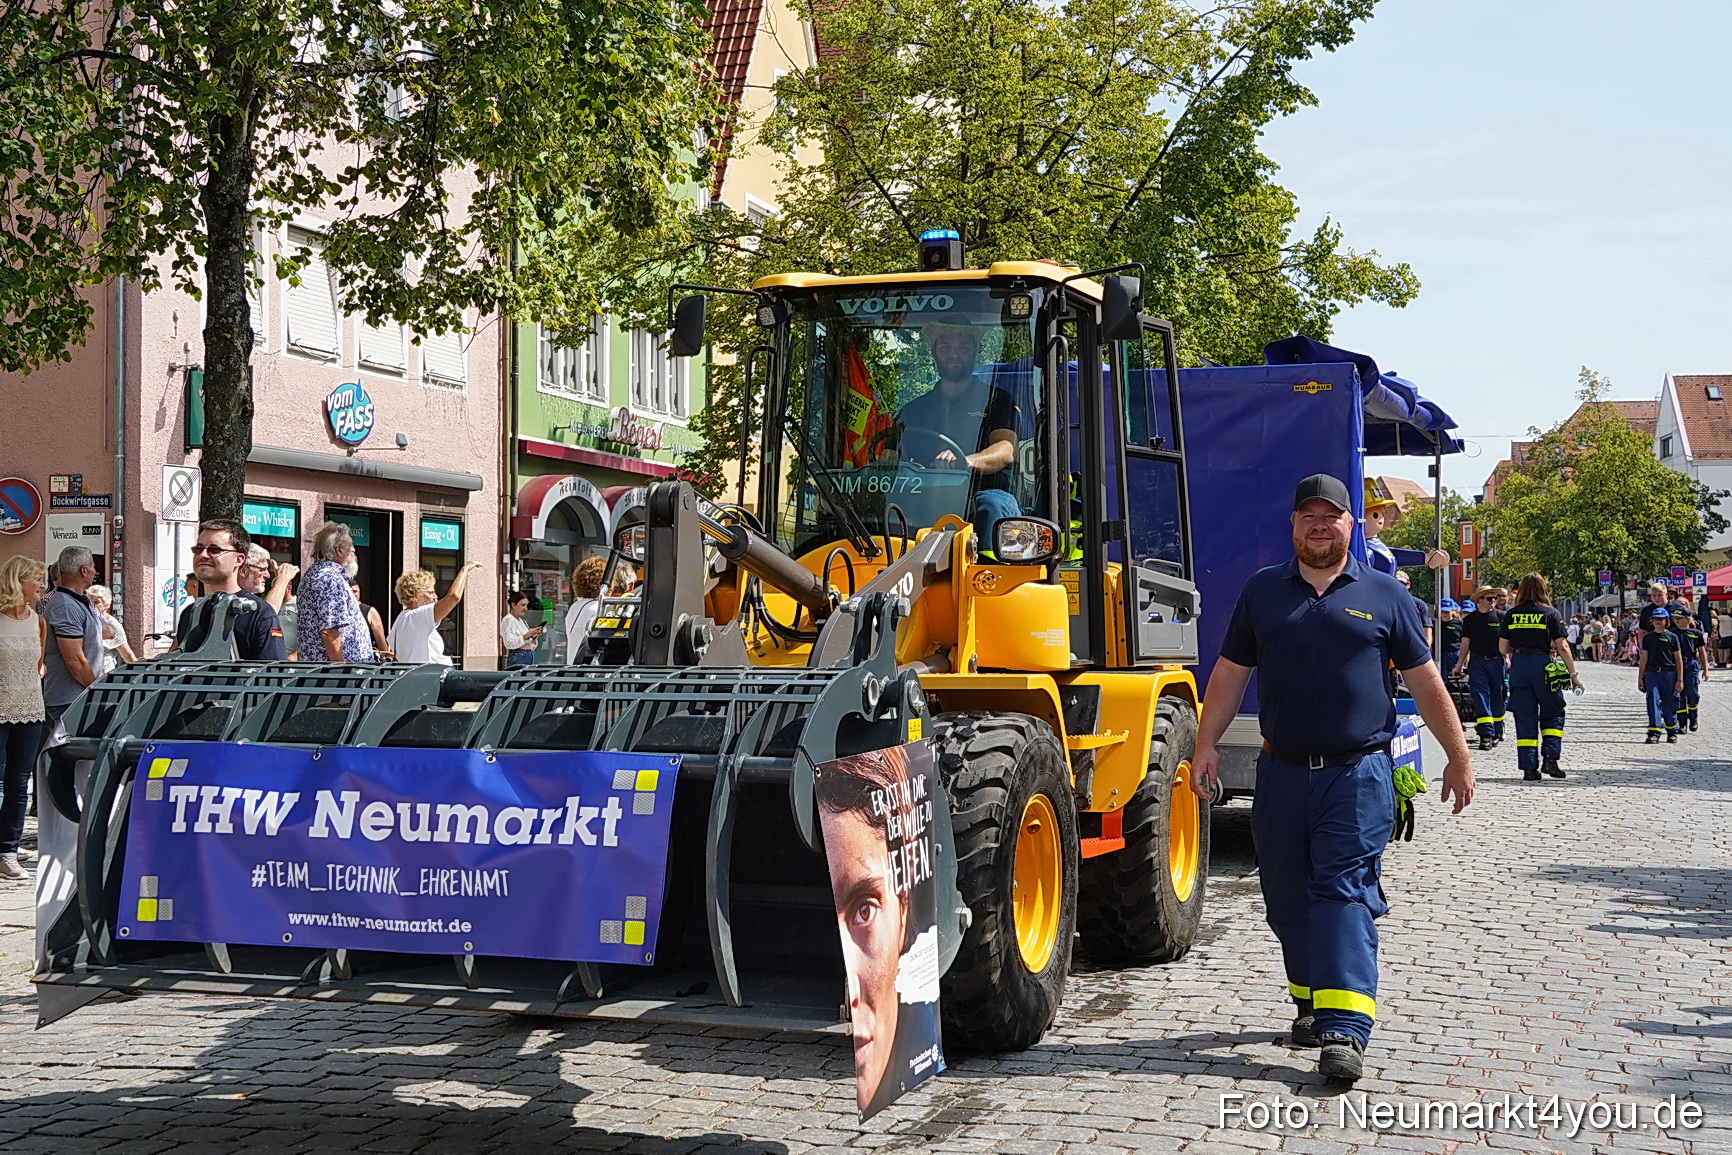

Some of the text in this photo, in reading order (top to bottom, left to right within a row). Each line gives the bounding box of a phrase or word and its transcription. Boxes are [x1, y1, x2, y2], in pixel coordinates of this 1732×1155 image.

[836, 294, 954, 314] VOLVO
[327, 389, 353, 412] vom
[335, 403, 374, 437] FASS
[612, 406, 667, 451] Bögerl
[831, 475, 923, 494] NM 86/72
[52, 496, 109, 508] Bockwirtsgasse
[171, 508, 191, 518] ZONE
[262, 511, 294, 532] Whisky
[52, 530, 78, 540] Venezia
[83, 527, 101, 535] SUNNY
[424, 526, 455, 543] Essig Öl
[1695, 573, 1704, 585] P
[1511, 613, 1544, 624] THW
[870, 789, 887, 817] ER
[885, 782, 900, 811] IST
[900, 779, 912, 806] IN
[168, 784, 624, 848] THW Neumarkt
[886, 799, 933, 842] DER WILLE ZU
[881, 836, 933, 900] HELFEN.
[250, 859, 511, 899] #TEAM_TECHNIK_EHRENAMT
[287, 910, 473, 935] www.thw-neumarkt.de
